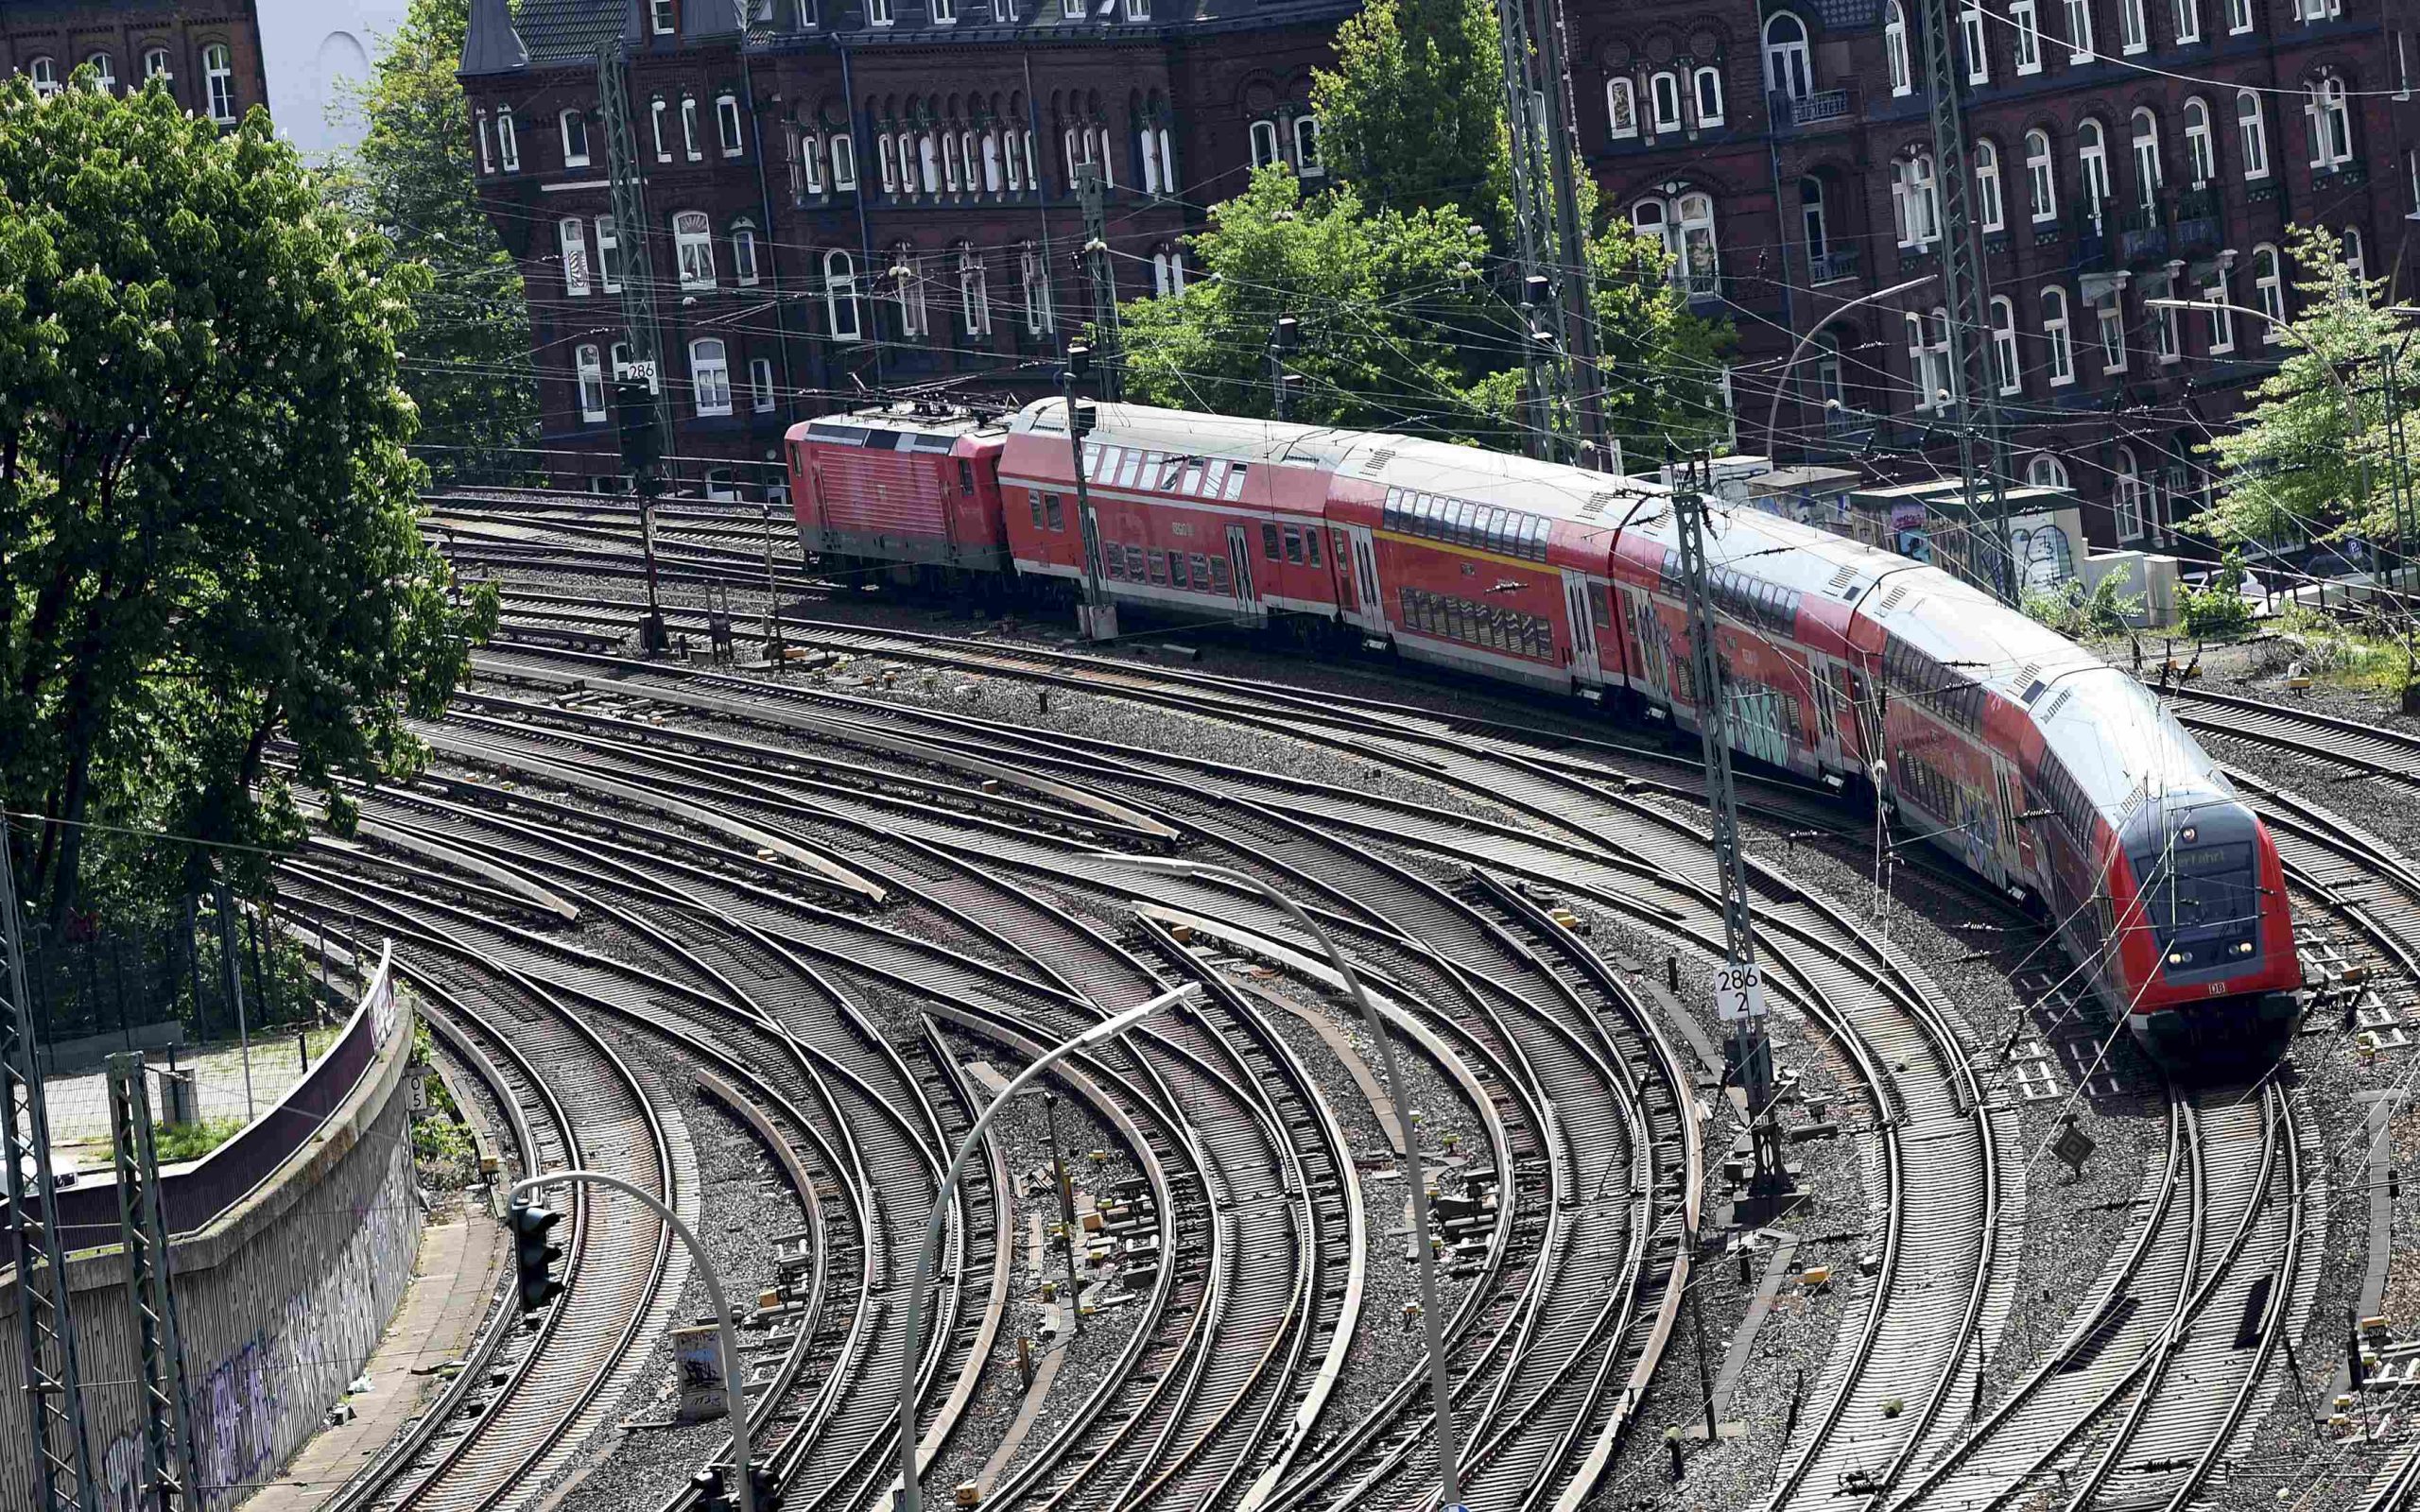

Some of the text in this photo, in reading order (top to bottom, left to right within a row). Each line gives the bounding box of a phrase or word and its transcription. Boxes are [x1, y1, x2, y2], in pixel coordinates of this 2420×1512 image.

[630, 363, 654, 378] 286
[2350, 541, 2358, 553] P
[1718, 967, 1758, 991] 286
[2209, 983, 2225, 994] DB
[1735, 992, 1749, 1012] 2
[413, 1093, 422, 1108] 5
